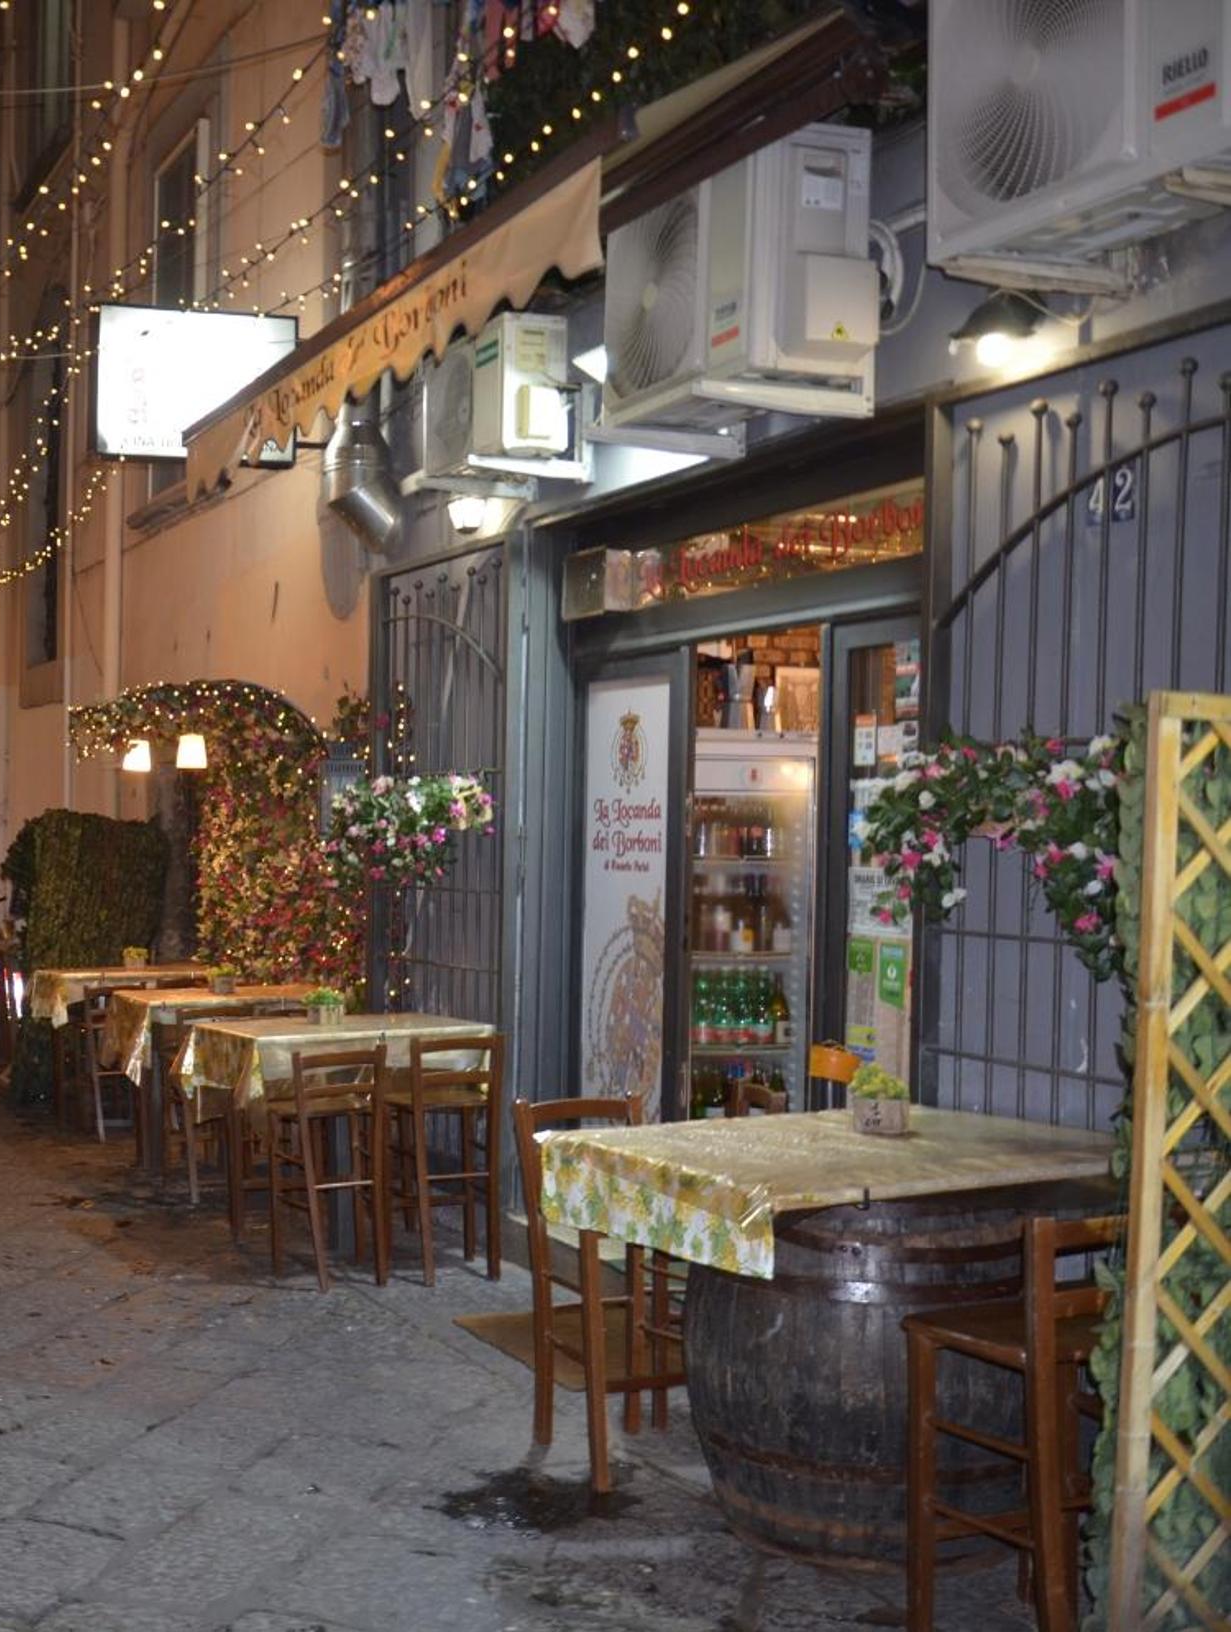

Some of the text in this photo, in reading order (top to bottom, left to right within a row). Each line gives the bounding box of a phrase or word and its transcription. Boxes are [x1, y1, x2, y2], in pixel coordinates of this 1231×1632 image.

[1162, 48, 1209, 86] RIELLO
[1089, 468, 1132, 512] 42
[594, 797, 661, 828] La Locanda
[592, 830, 663, 858] dei Borboni
